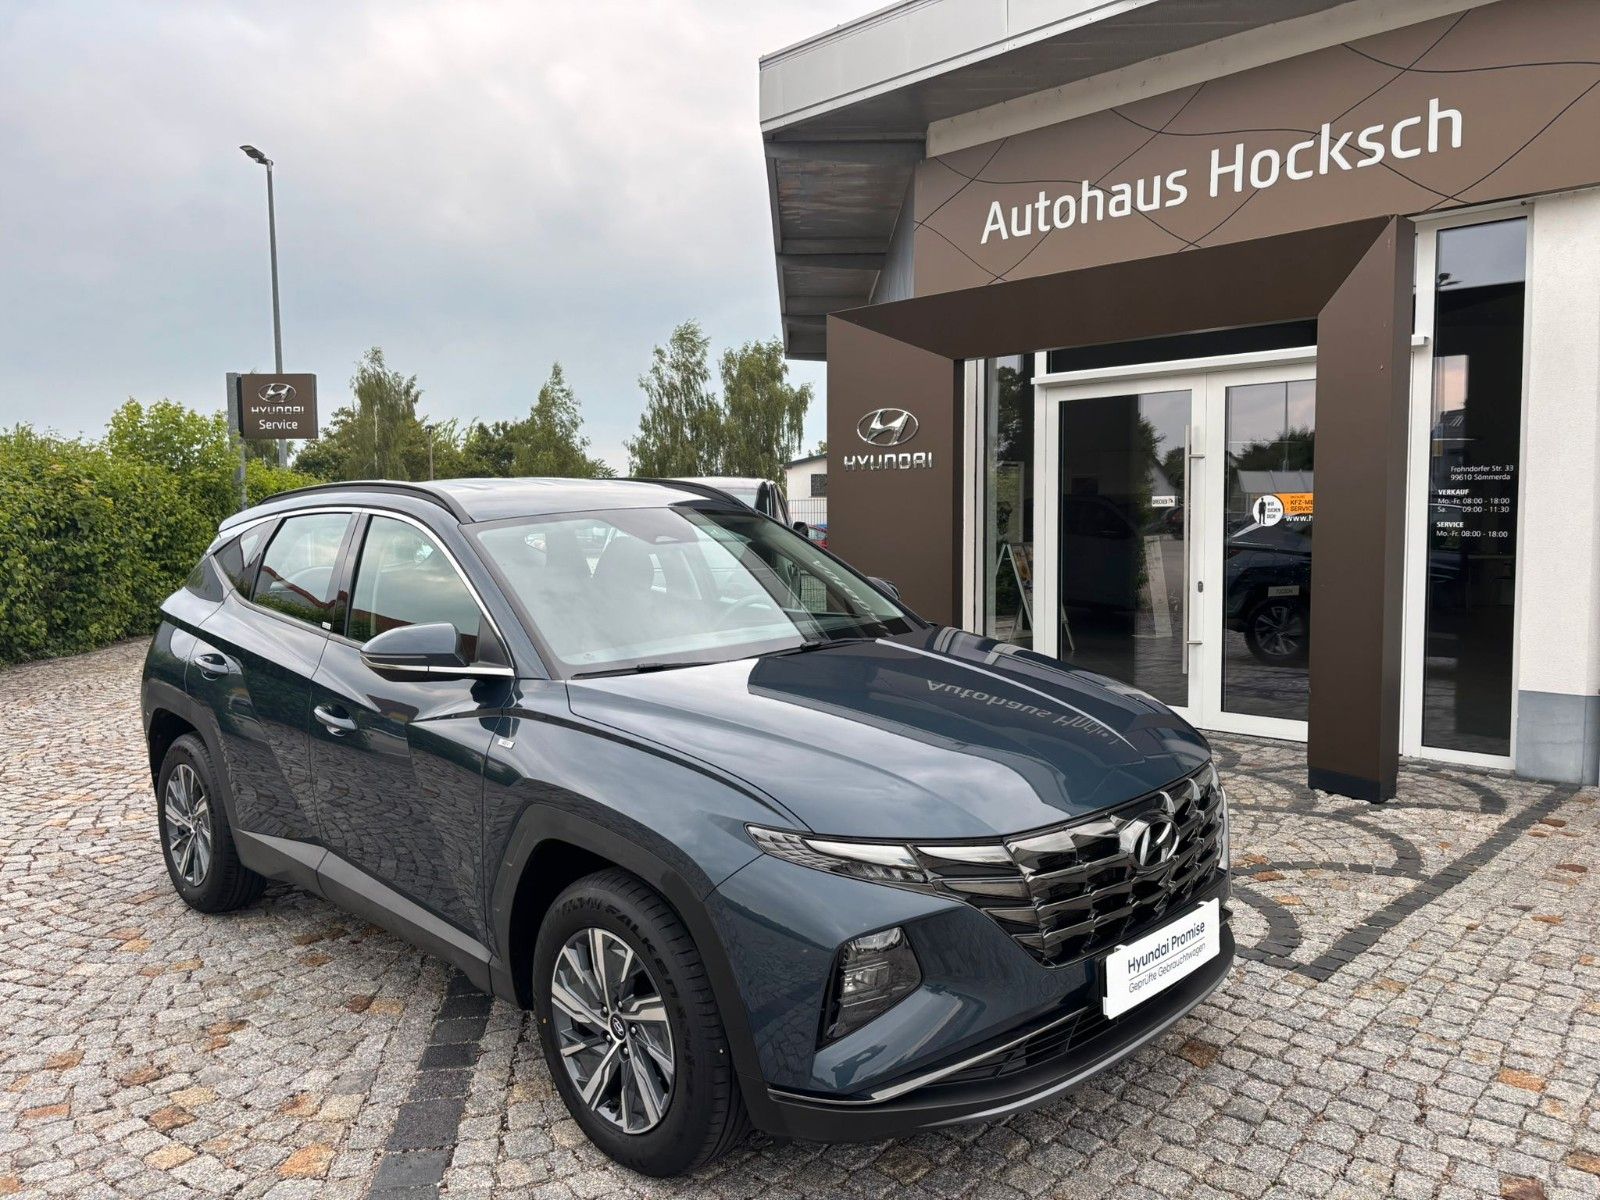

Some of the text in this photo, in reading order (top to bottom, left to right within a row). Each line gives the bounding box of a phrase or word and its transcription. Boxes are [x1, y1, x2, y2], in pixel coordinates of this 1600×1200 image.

[980, 97, 1463, 245] Autohaus Hocksch
[251, 406, 304, 415] HYUNDAI
[258, 419, 298, 430] Service
[843, 452, 932, 471] HYUNDAI
[1450, 465, 1490, 473] Frohndorfer
[1438, 488, 1470, 496] VERKAUF
[1127, 921, 1206, 974] Hyundai Promise
[1128, 942, 1206, 993] Geprüfte Gebrauchtwagen
